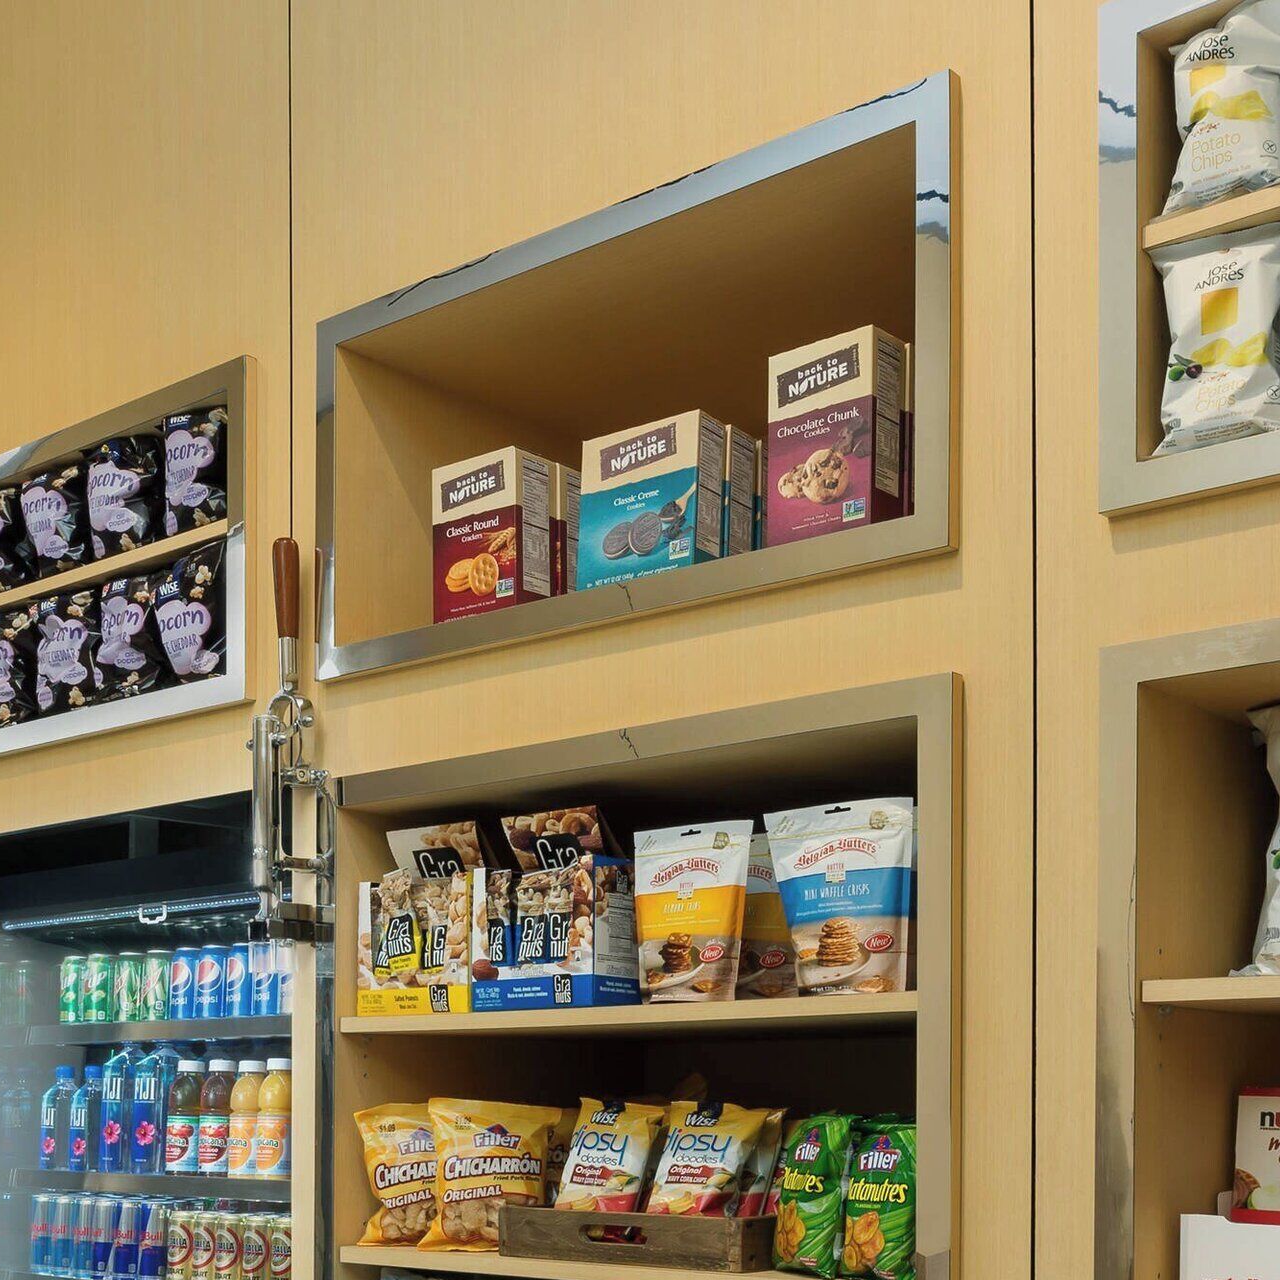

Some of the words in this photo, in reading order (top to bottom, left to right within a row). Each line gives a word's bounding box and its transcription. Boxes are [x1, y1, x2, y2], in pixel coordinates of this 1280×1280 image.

[798, 365, 823, 380] back
[828, 358, 838, 366] to
[777, 417, 824, 439] Chocolate
[827, 407, 860, 424] Chunk
[804, 427, 831, 439] Cookies
[620, 441, 643, 454] back
[457, 475, 477, 489] back
[614, 493, 637, 507] Classic
[638, 489, 660, 500] Creme
[446, 521, 472, 538] Classic
[474, 516, 499, 532] Round
[462, 534, 483, 543] Crackers
[112, 579, 127, 592] WISE
[160, 582, 179, 596] WISE
[795, 846, 834, 869] Belgian
[651, 864, 683, 885] Belgian
[847, 884, 871, 896] CRISPS
[388, 918, 409, 937] Gra
[554, 976, 571, 992] Gra
[431, 987, 447, 1001] Gra
[135, 1078, 158, 1100] FIJI
[686, 1114, 718, 1126] WISE
[860, 1150, 899, 1170] Filler
[670, 1166, 702, 1175] Original
[443, 1185, 502, 1202] ORIGINAL
[144, 1231, 163, 1240] Bull
